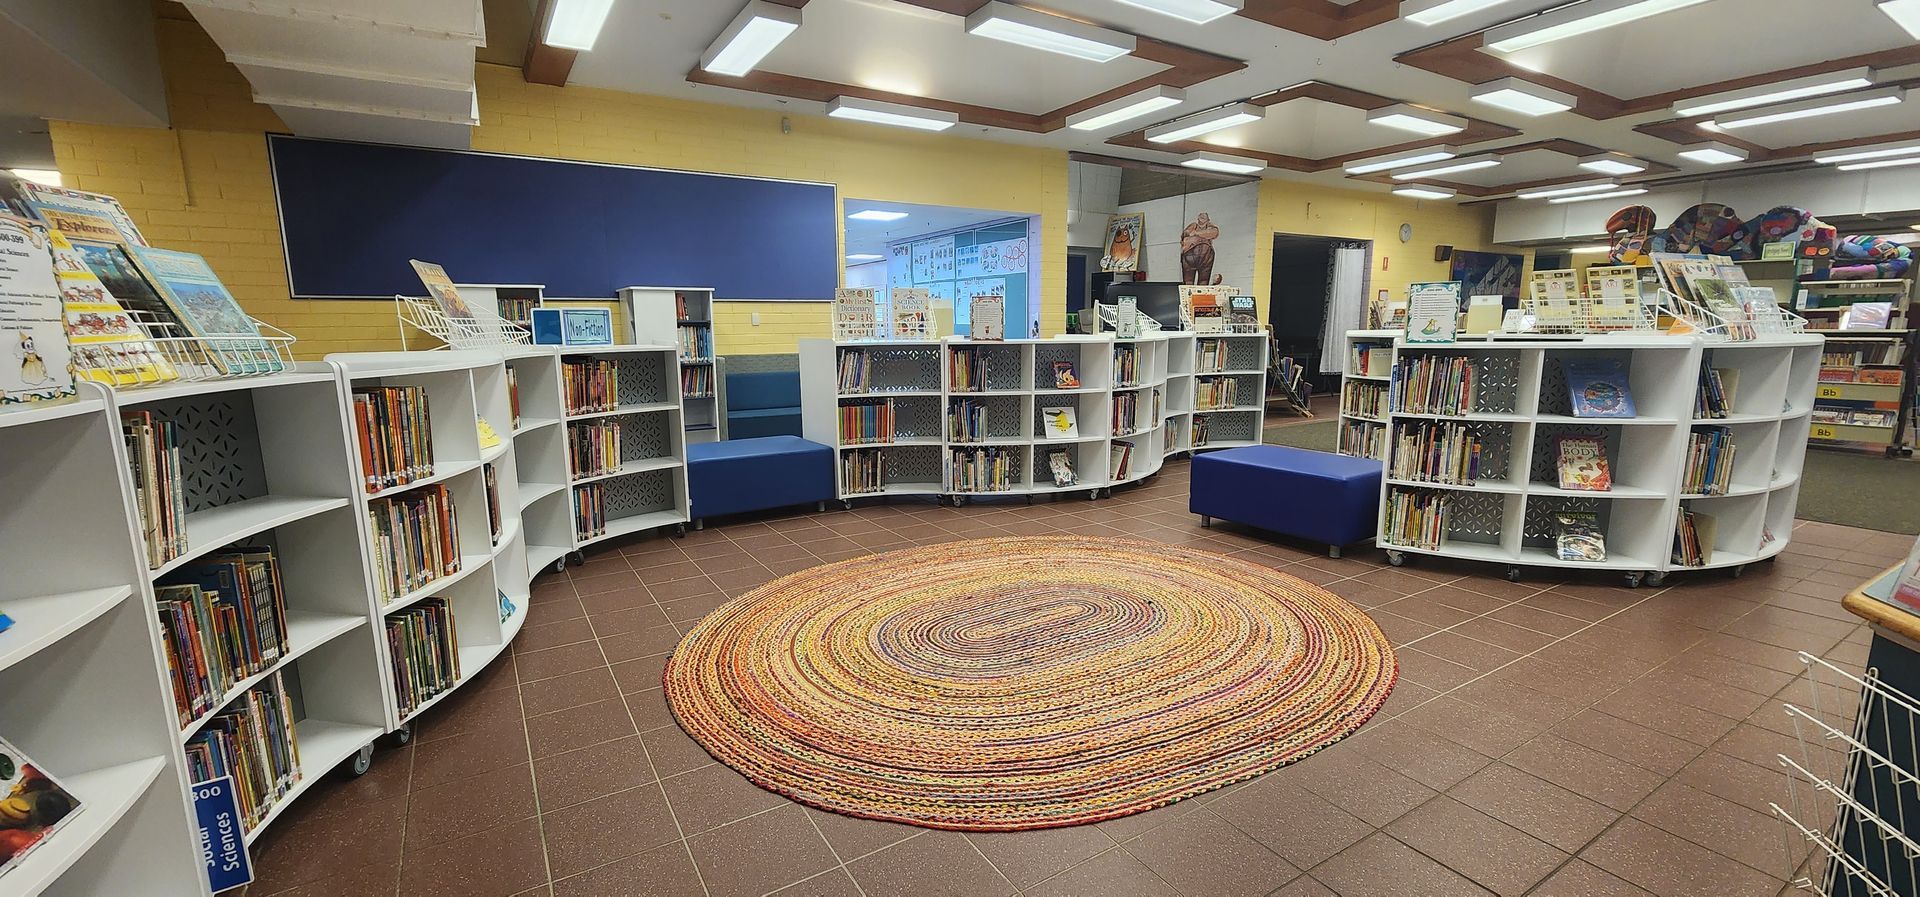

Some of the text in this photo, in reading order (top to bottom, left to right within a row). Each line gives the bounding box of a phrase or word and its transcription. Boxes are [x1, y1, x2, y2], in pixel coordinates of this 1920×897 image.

[569, 319, 605, 337] Non-Fiction
[1822, 388, 1837, 397] Bb
[1817, 428, 1832, 437] Bb
[1563, 447, 1598, 460] BODY
[216, 812, 240, 872] Sciences
